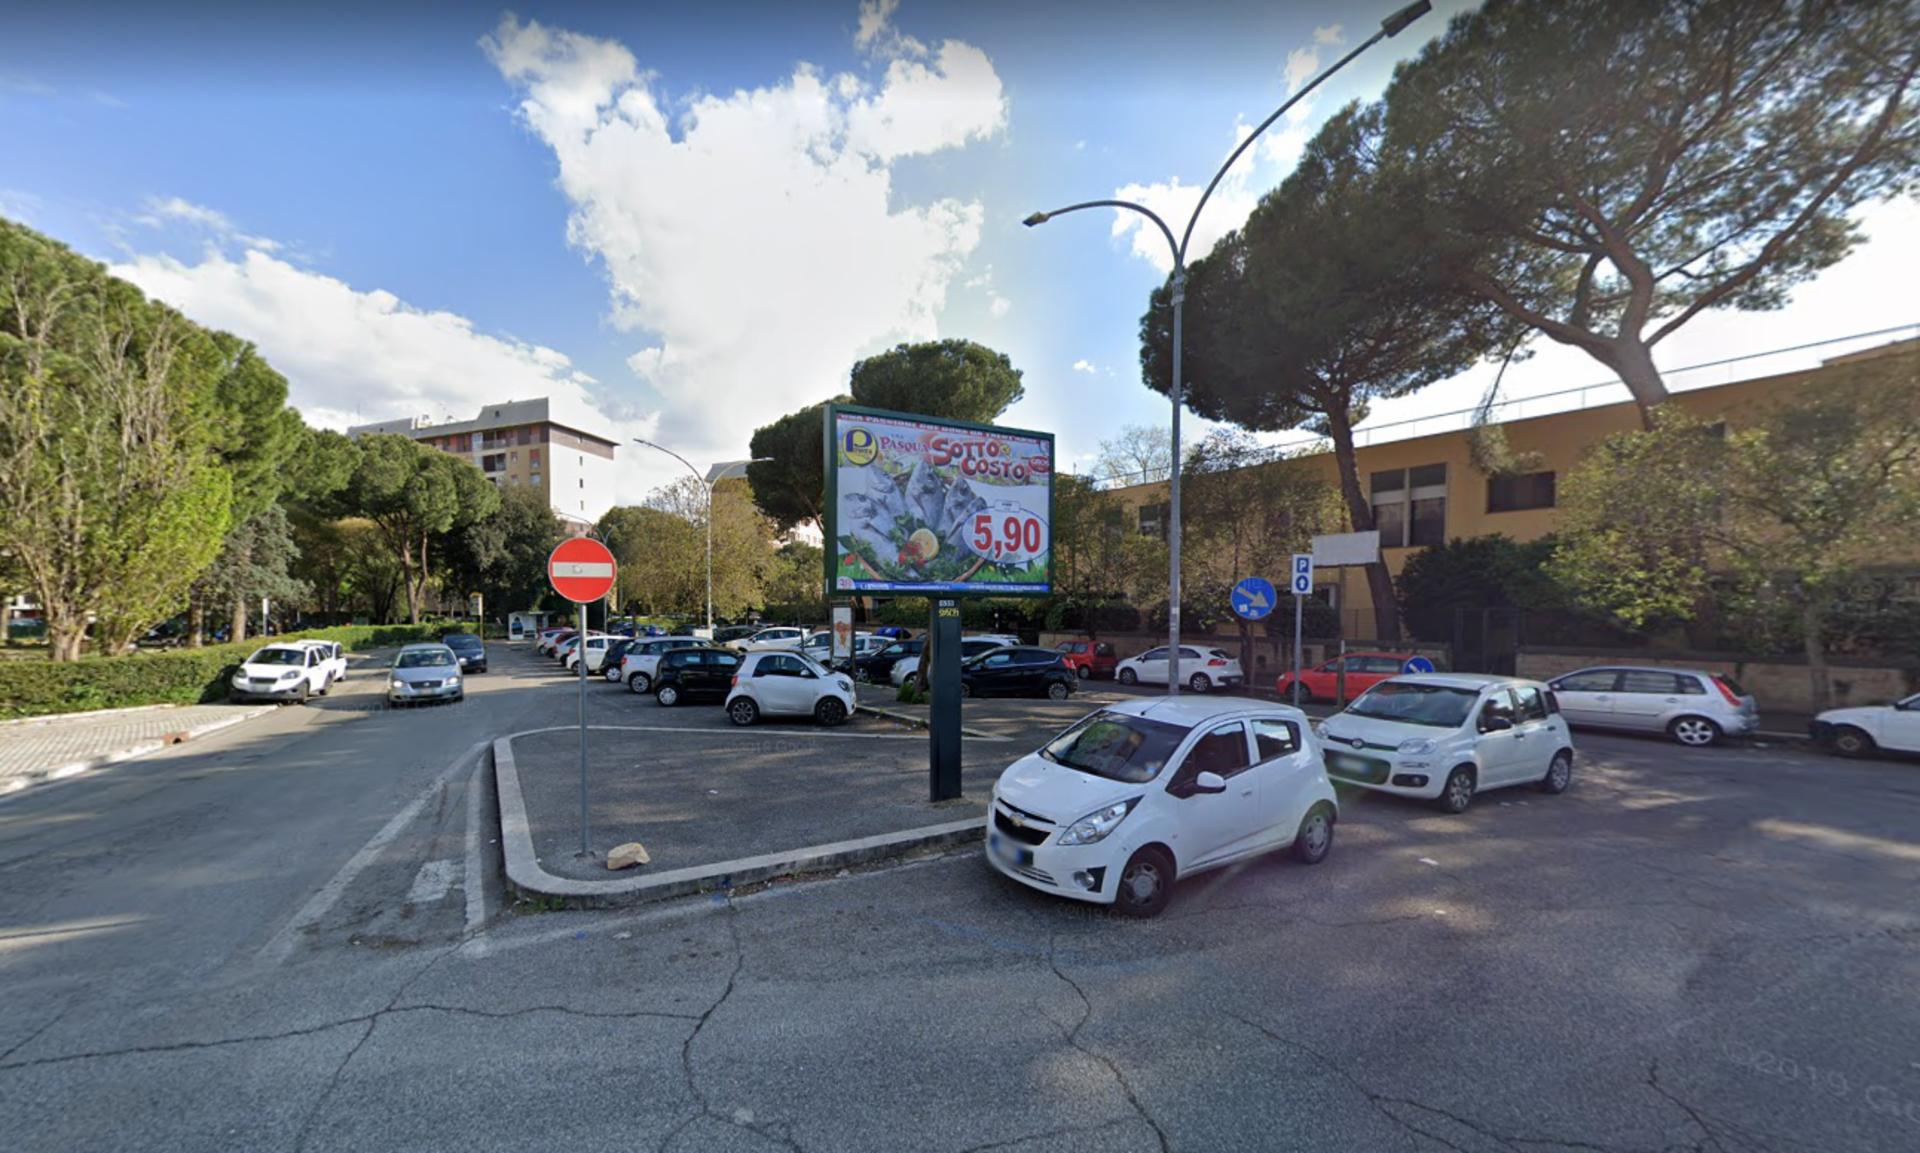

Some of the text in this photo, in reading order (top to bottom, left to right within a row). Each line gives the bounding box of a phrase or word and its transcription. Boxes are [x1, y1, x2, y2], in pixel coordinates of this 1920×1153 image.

[880, 436, 930, 453] PASQUA
[931, 437, 1001, 466] SOTTO
[961, 455, 1026, 480] COSTO
[974, 514, 1041, 560] 5,90
[1299, 559, 1307, 571] P
